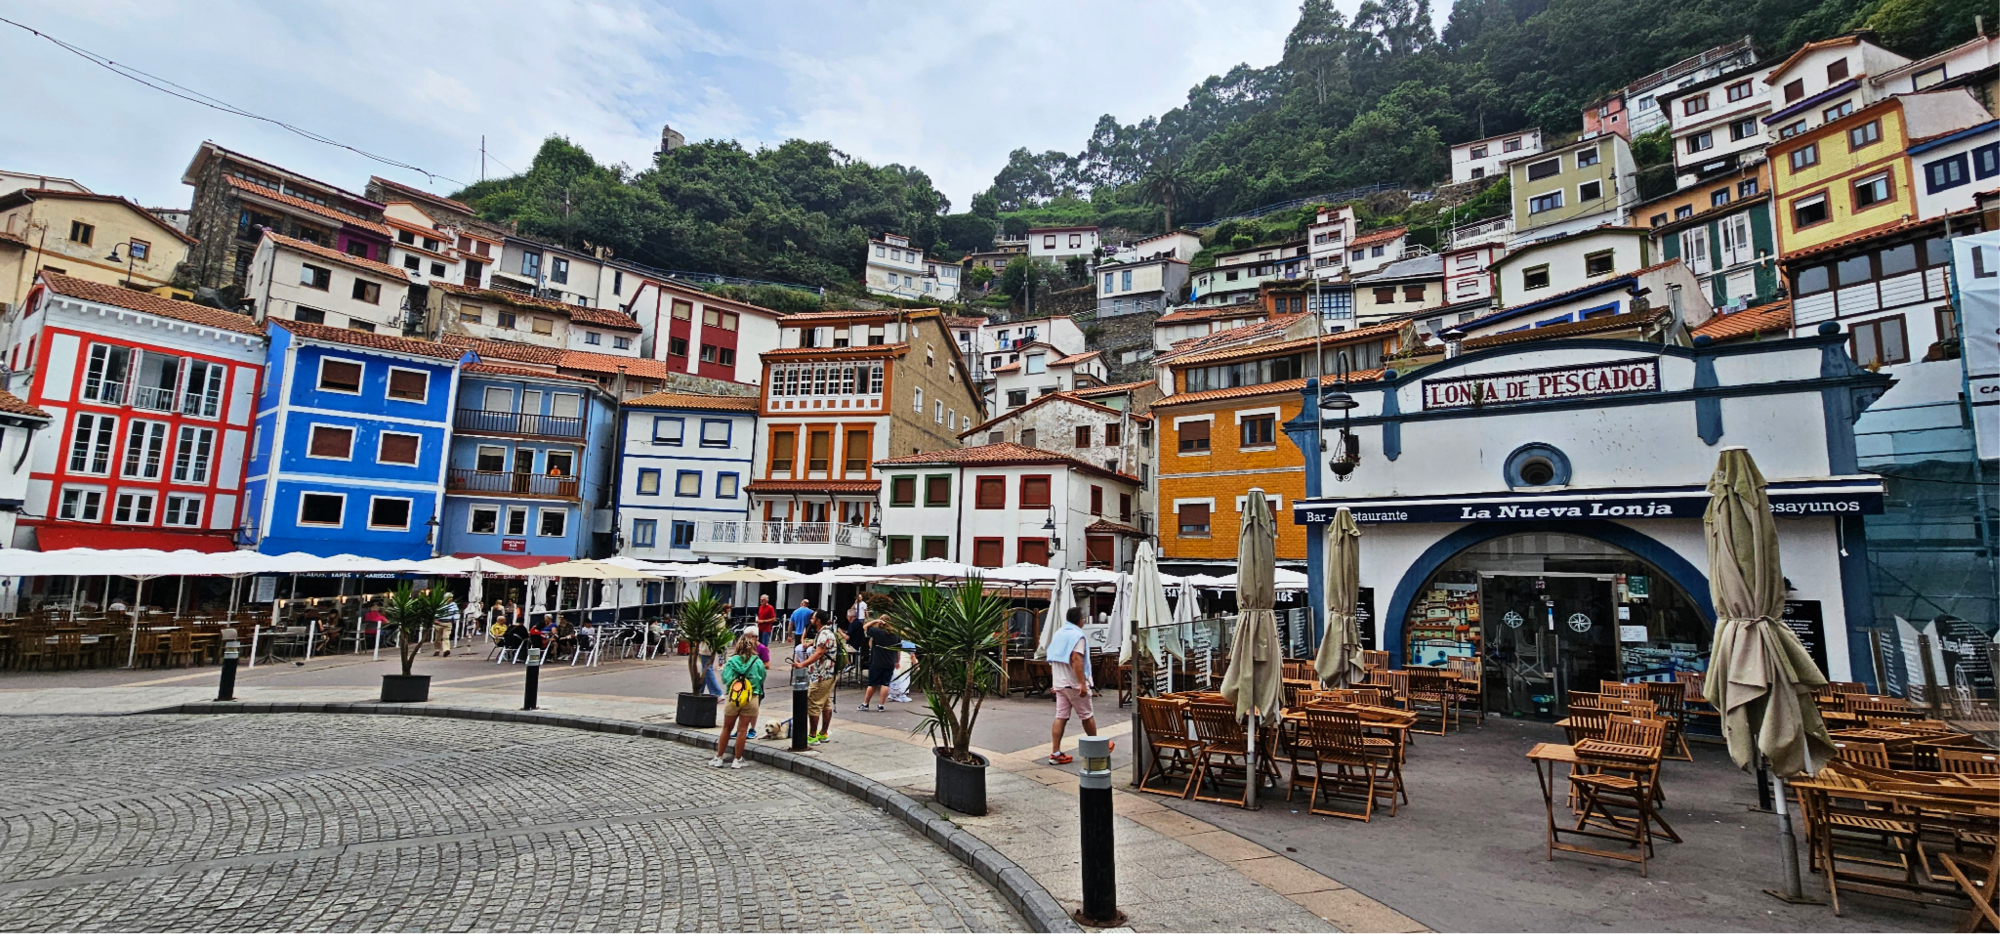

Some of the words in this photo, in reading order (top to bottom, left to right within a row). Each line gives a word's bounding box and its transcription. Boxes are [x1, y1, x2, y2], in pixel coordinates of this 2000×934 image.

[1506, 380, 1530, 399] DE
[1538, 367, 1648, 396] PESCADO
[1460, 507, 1491, 519] La
[1497, 505, 1582, 518] Nueva
[1589, 502, 1673, 517] Lonja
[1768, 501, 1860, 514] esayunos
[1306, 512, 1326, 522] Bar
[1352, 510, 1408, 521] staurante
